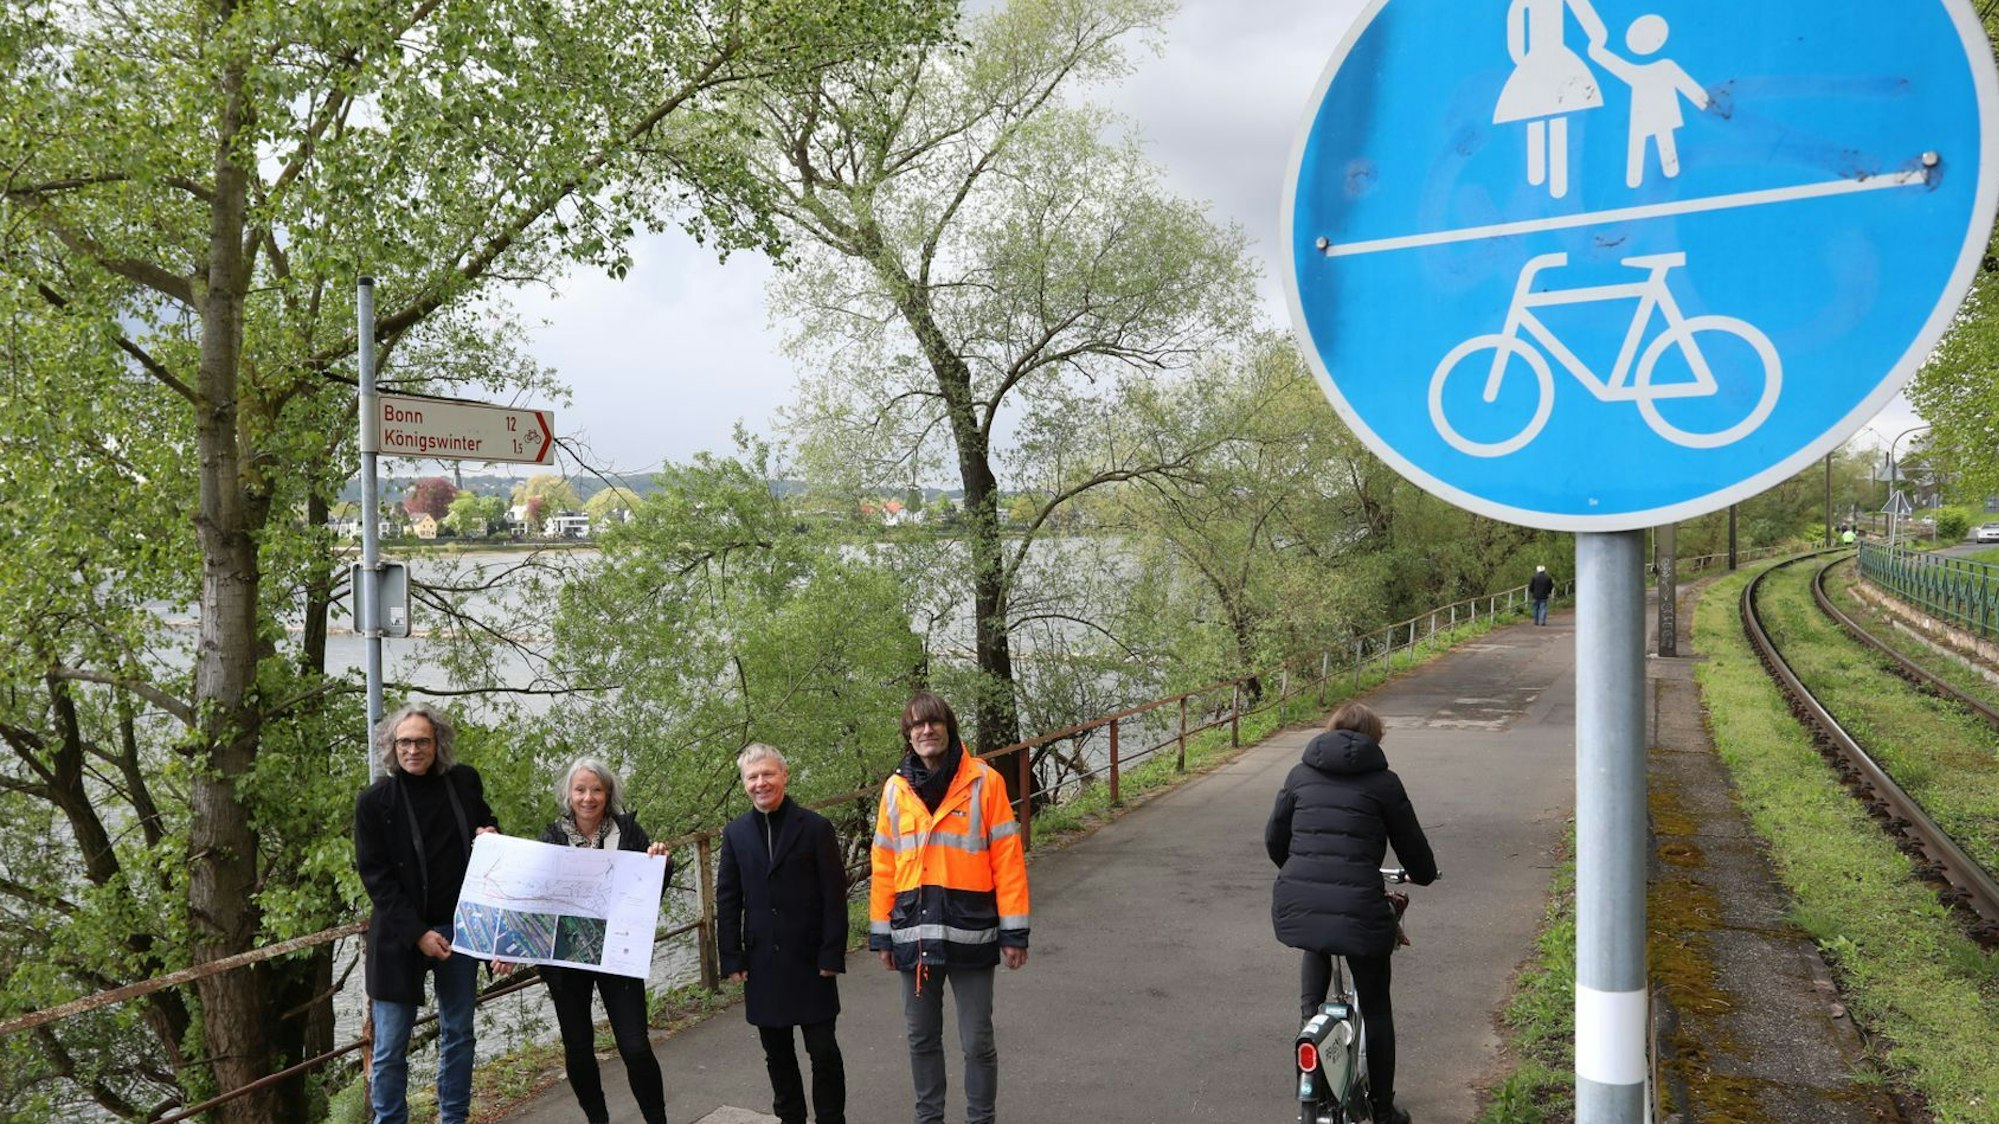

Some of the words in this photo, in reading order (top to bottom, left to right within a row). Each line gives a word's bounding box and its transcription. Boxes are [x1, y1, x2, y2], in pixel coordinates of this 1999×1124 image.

[384, 404, 423, 424] Bonn
[506, 416, 517, 432] 12
[384, 429, 482, 452] Königswinter
